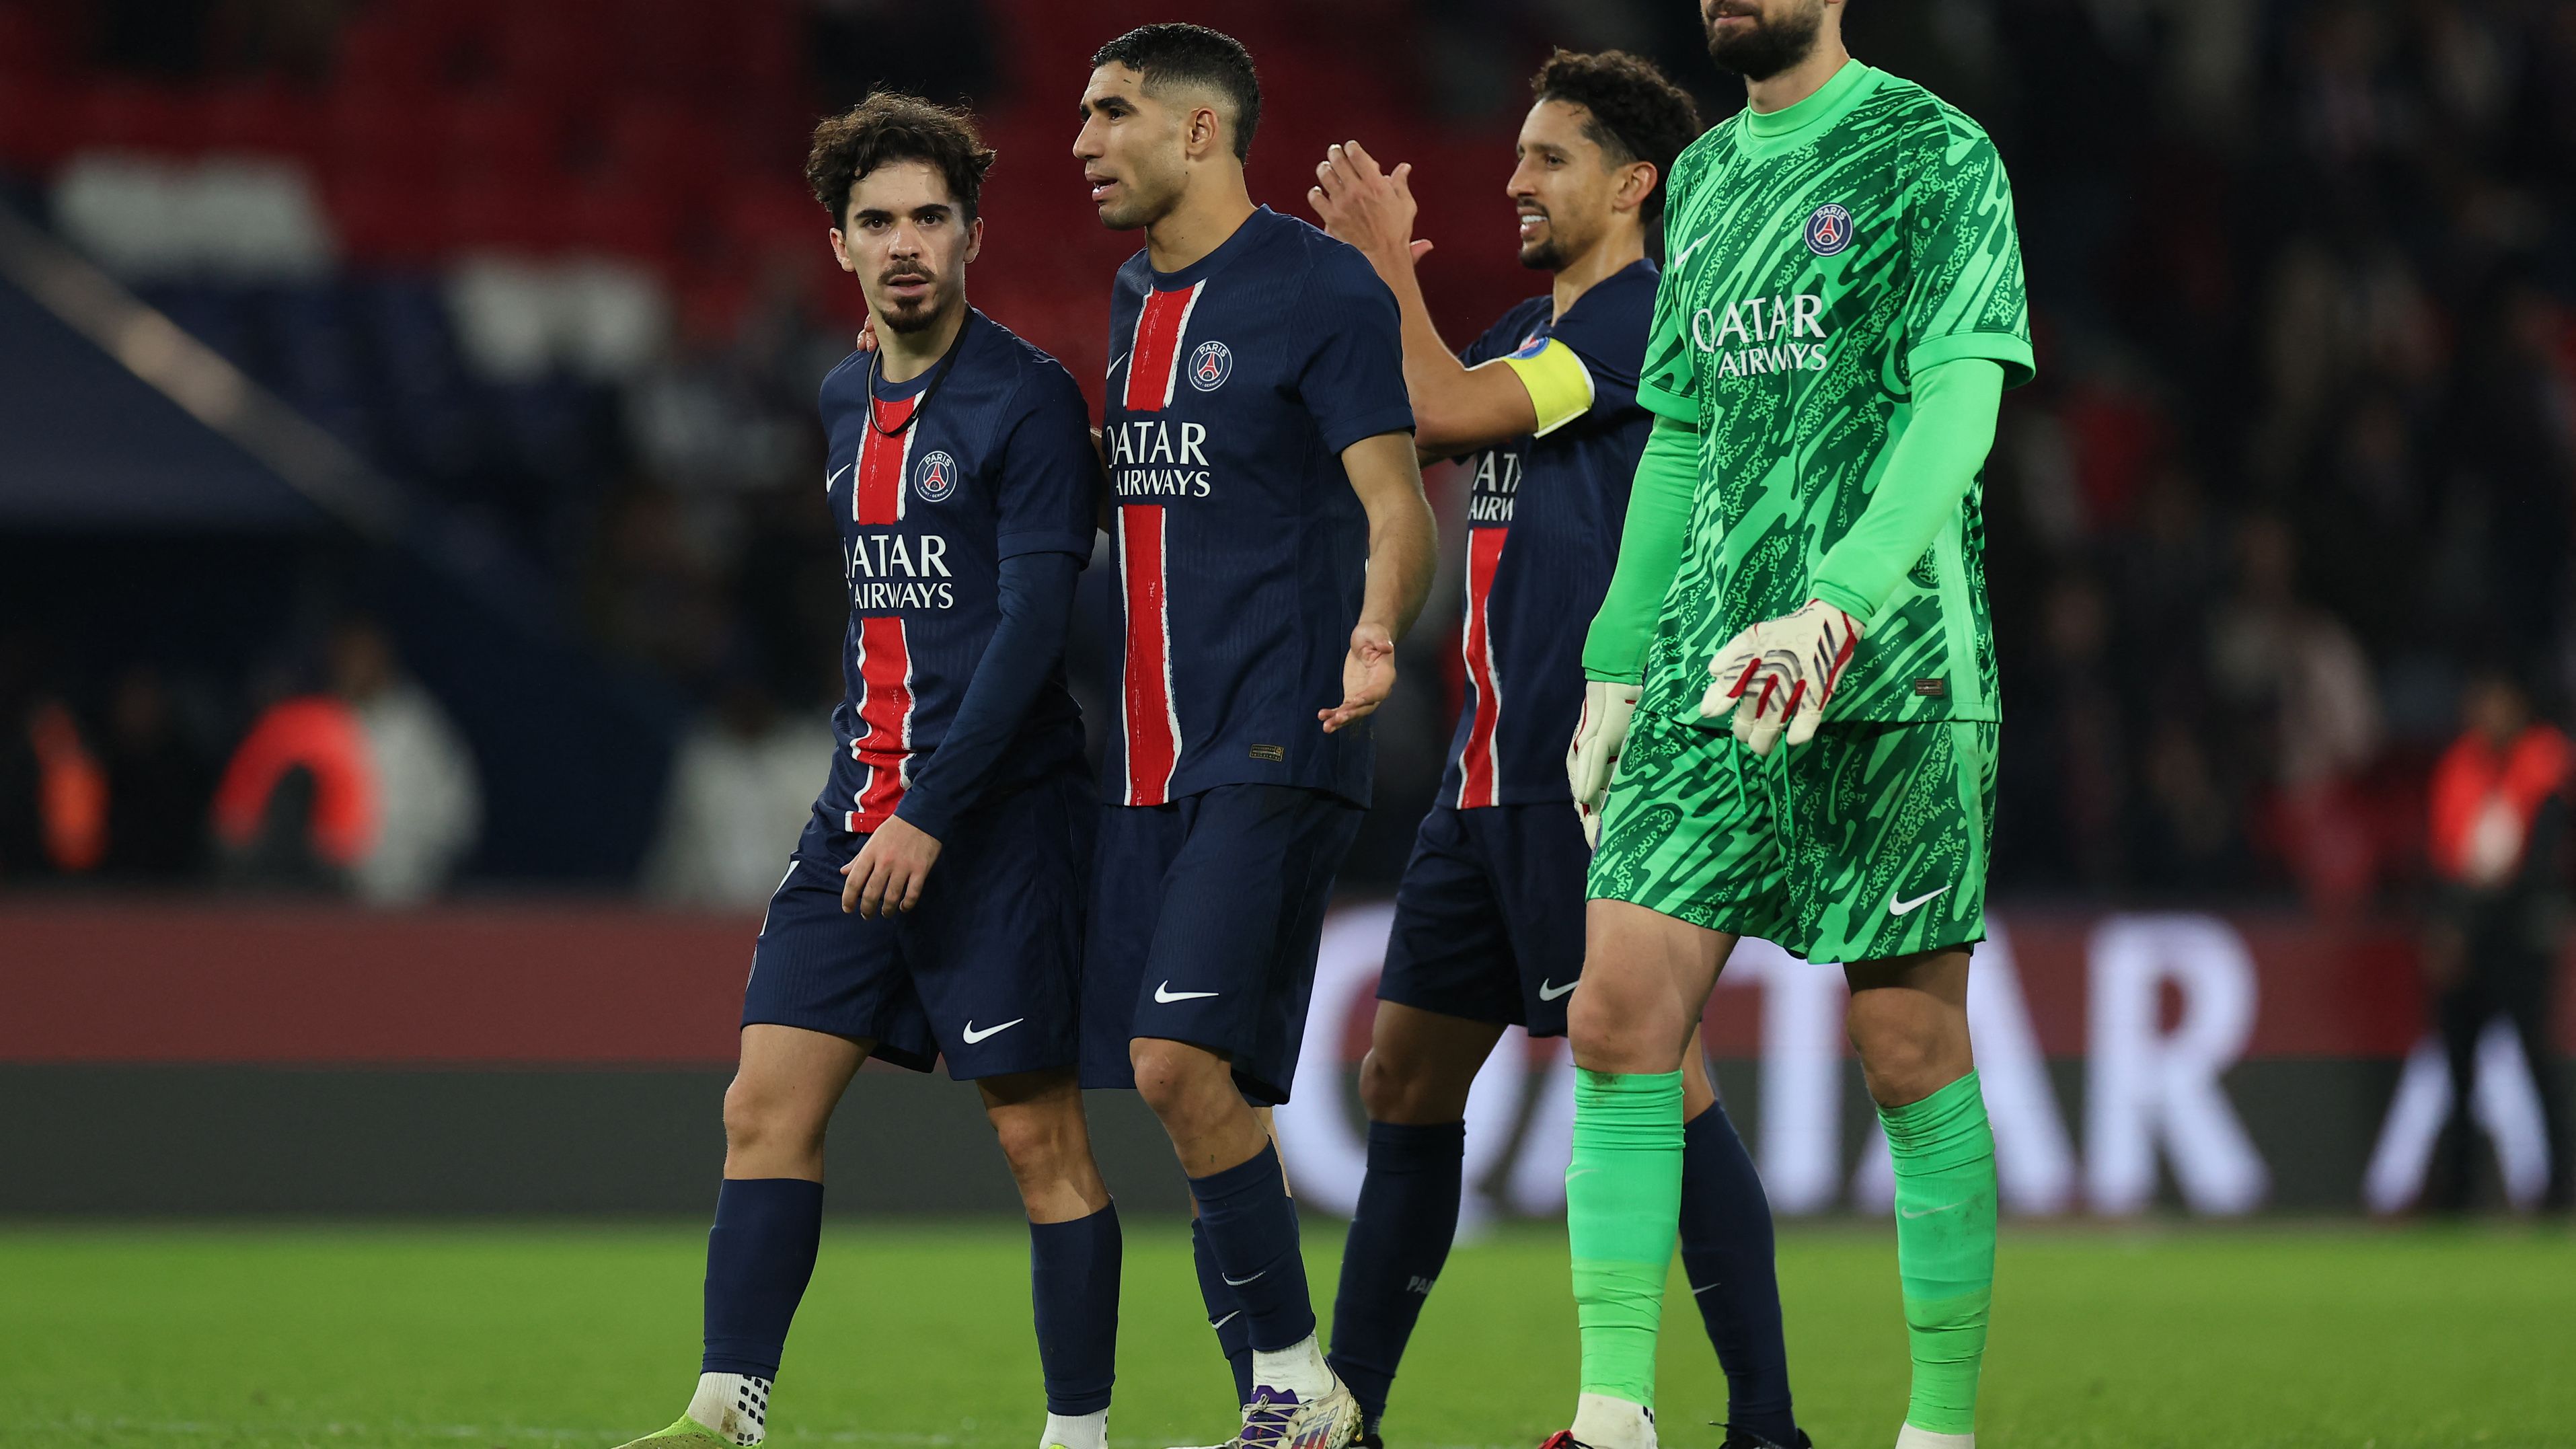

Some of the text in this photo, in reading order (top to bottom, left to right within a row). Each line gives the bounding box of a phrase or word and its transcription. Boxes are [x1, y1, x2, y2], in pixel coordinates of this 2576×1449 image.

[1817, 207, 1847, 221] PARIS
[1692, 295, 1827, 354] QATAR
[1199, 344, 1227, 357] PARIS
[925, 453, 951, 467] PARIS
[1115, 469, 1211, 497] AIRWAYS
[855, 583, 954, 609] AIRWAYS
